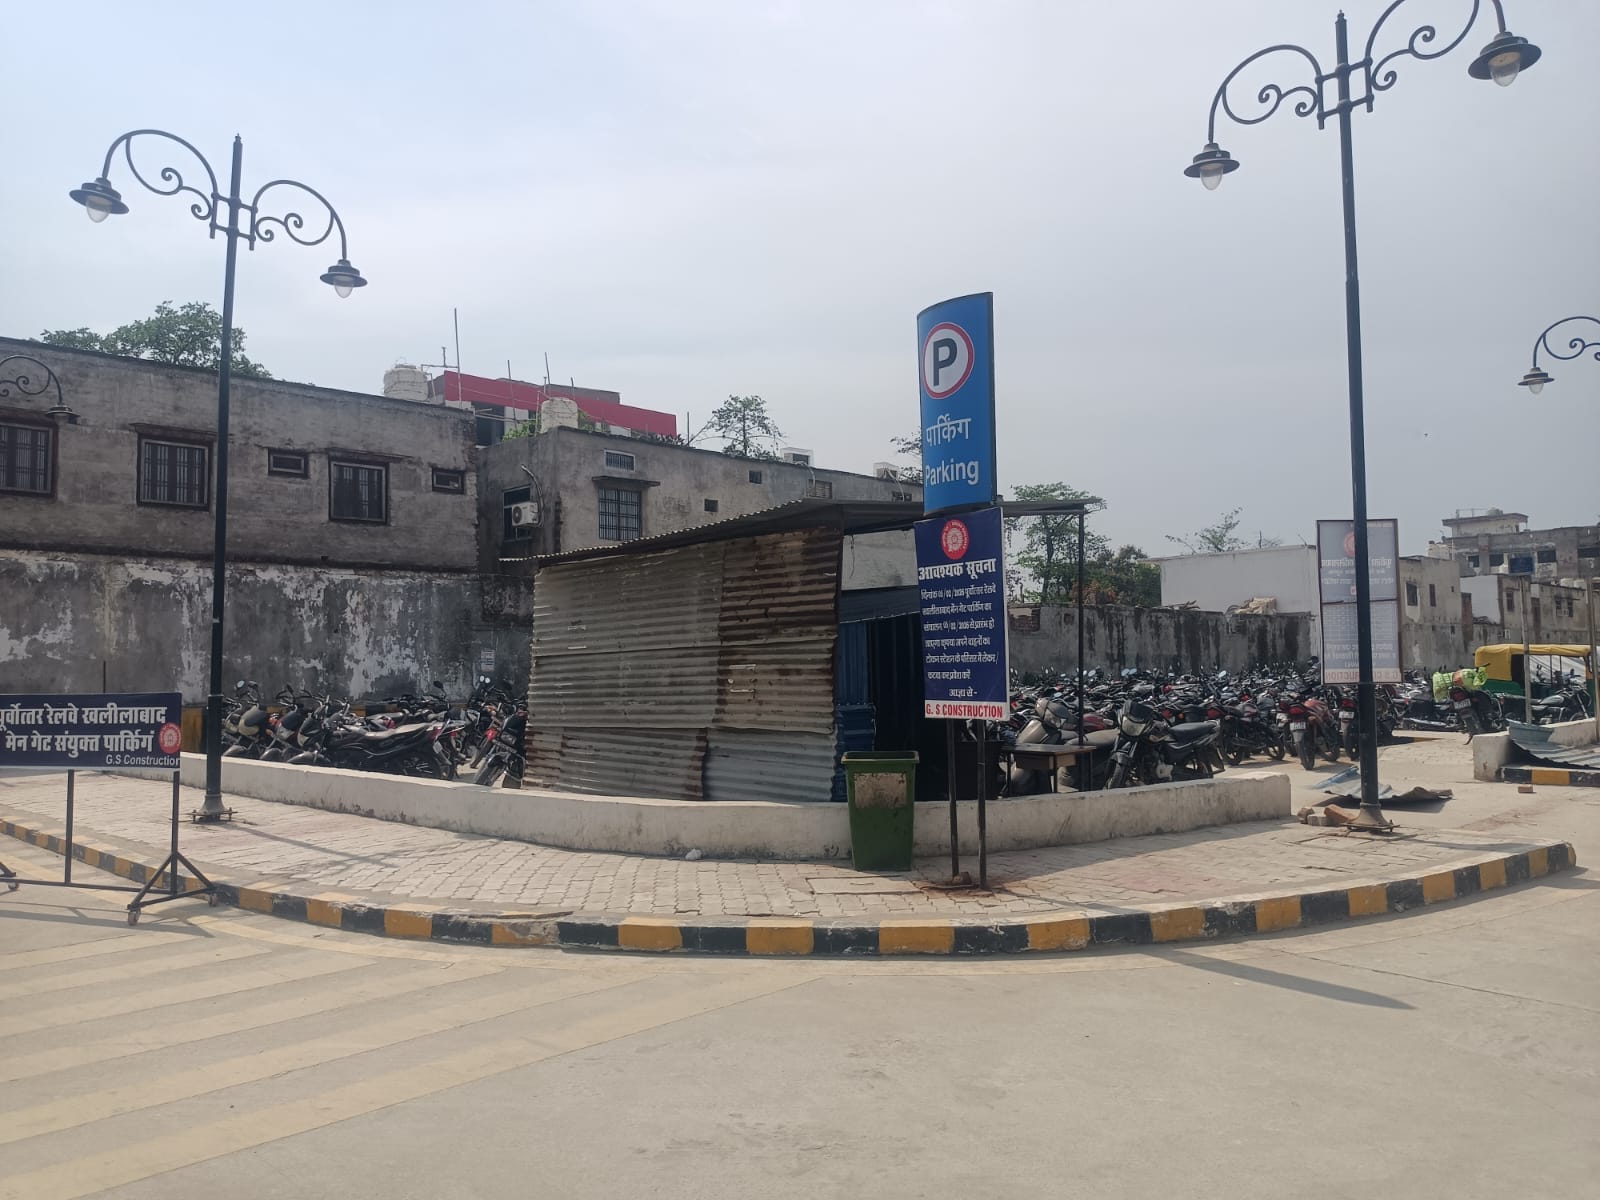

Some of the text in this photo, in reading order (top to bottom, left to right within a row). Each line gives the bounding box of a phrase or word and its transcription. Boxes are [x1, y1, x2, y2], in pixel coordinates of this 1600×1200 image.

[933, 338, 957, 386] P
[926, 413, 972, 447] पार्किंग
[925, 459, 979, 487] Parking
[919, 558, 996, 580] आवश्यक सूचना
[984, 583, 996, 593] रेलवे
[44, 703, 79, 725] रेलवे
[82, 703, 167, 725] खलीलाबाद
[936, 704, 940, 715] S
[943, 704, 1003, 717] CONSTRUCTION
[5, 731, 28, 752] मेन
[31, 731, 52, 752] गेट
[55, 731, 100, 758] संयुक्त
[106, 754, 121, 765] G.S
